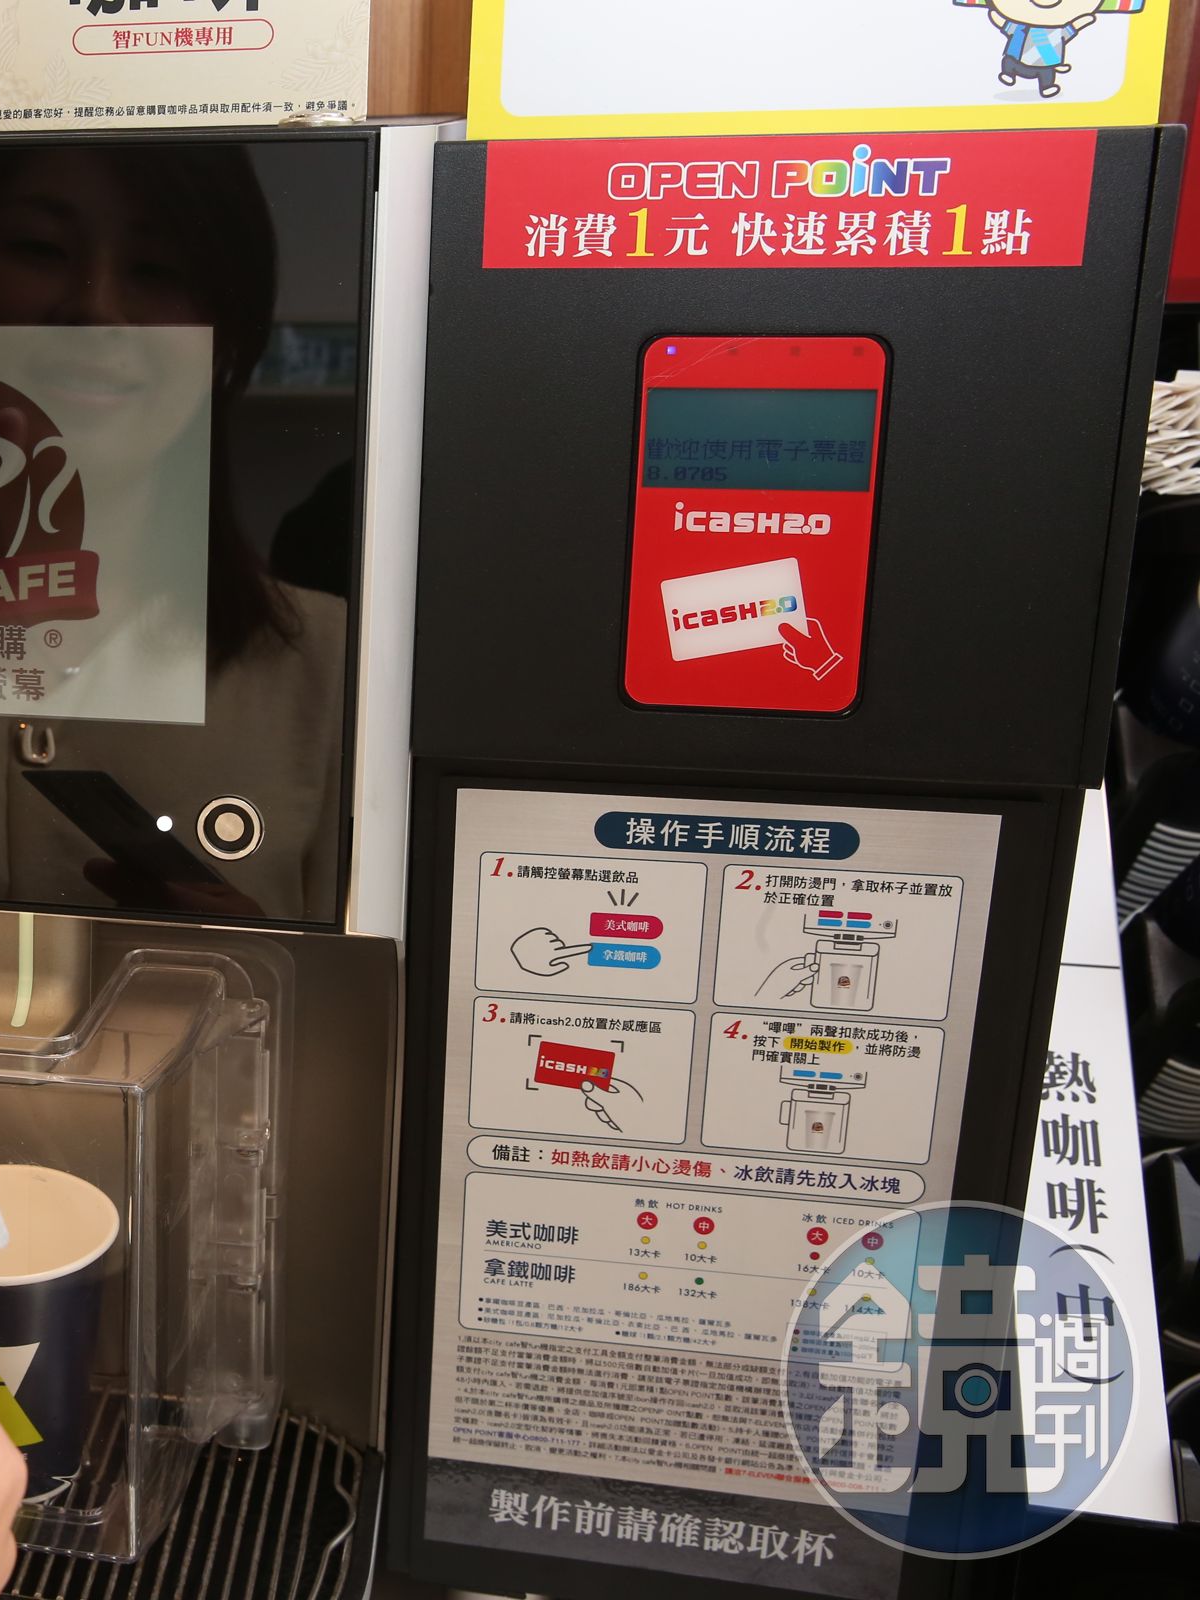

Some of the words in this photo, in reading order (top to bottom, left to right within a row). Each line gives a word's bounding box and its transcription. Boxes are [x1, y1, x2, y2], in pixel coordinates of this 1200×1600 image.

[112, 26, 234, 49] 智FUN機專用
[607, 160, 760, 200] OPEN
[524, 207, 710, 258] 消費1元
[731, 203, 1034, 257] 快速累積1點
[626, 817, 831, 854] 操作手順流程
[517, 865, 639, 884] 請觸控螢幕點選飲品
[763, 891, 834, 907] 於正確位置
[604, 919, 650, 933] 美式咖啡
[753, 1035, 780, 1049] 按下
[789, 1037, 846, 1053] 開始製作
[666, 1202, 685, 1210] HOT
[688, 1204, 723, 1214] DRINKS
[832, 1217, 855, 1226] ICED
[485, 1219, 579, 1245] 美式咖啡
[485, 1239, 542, 1250] AMERICANO
[483, 1258, 576, 1284] 拿鐵咖啡
[509, 1279, 534, 1288] LATTE
[489, 1489, 837, 1567] 製作前請確認取杯
